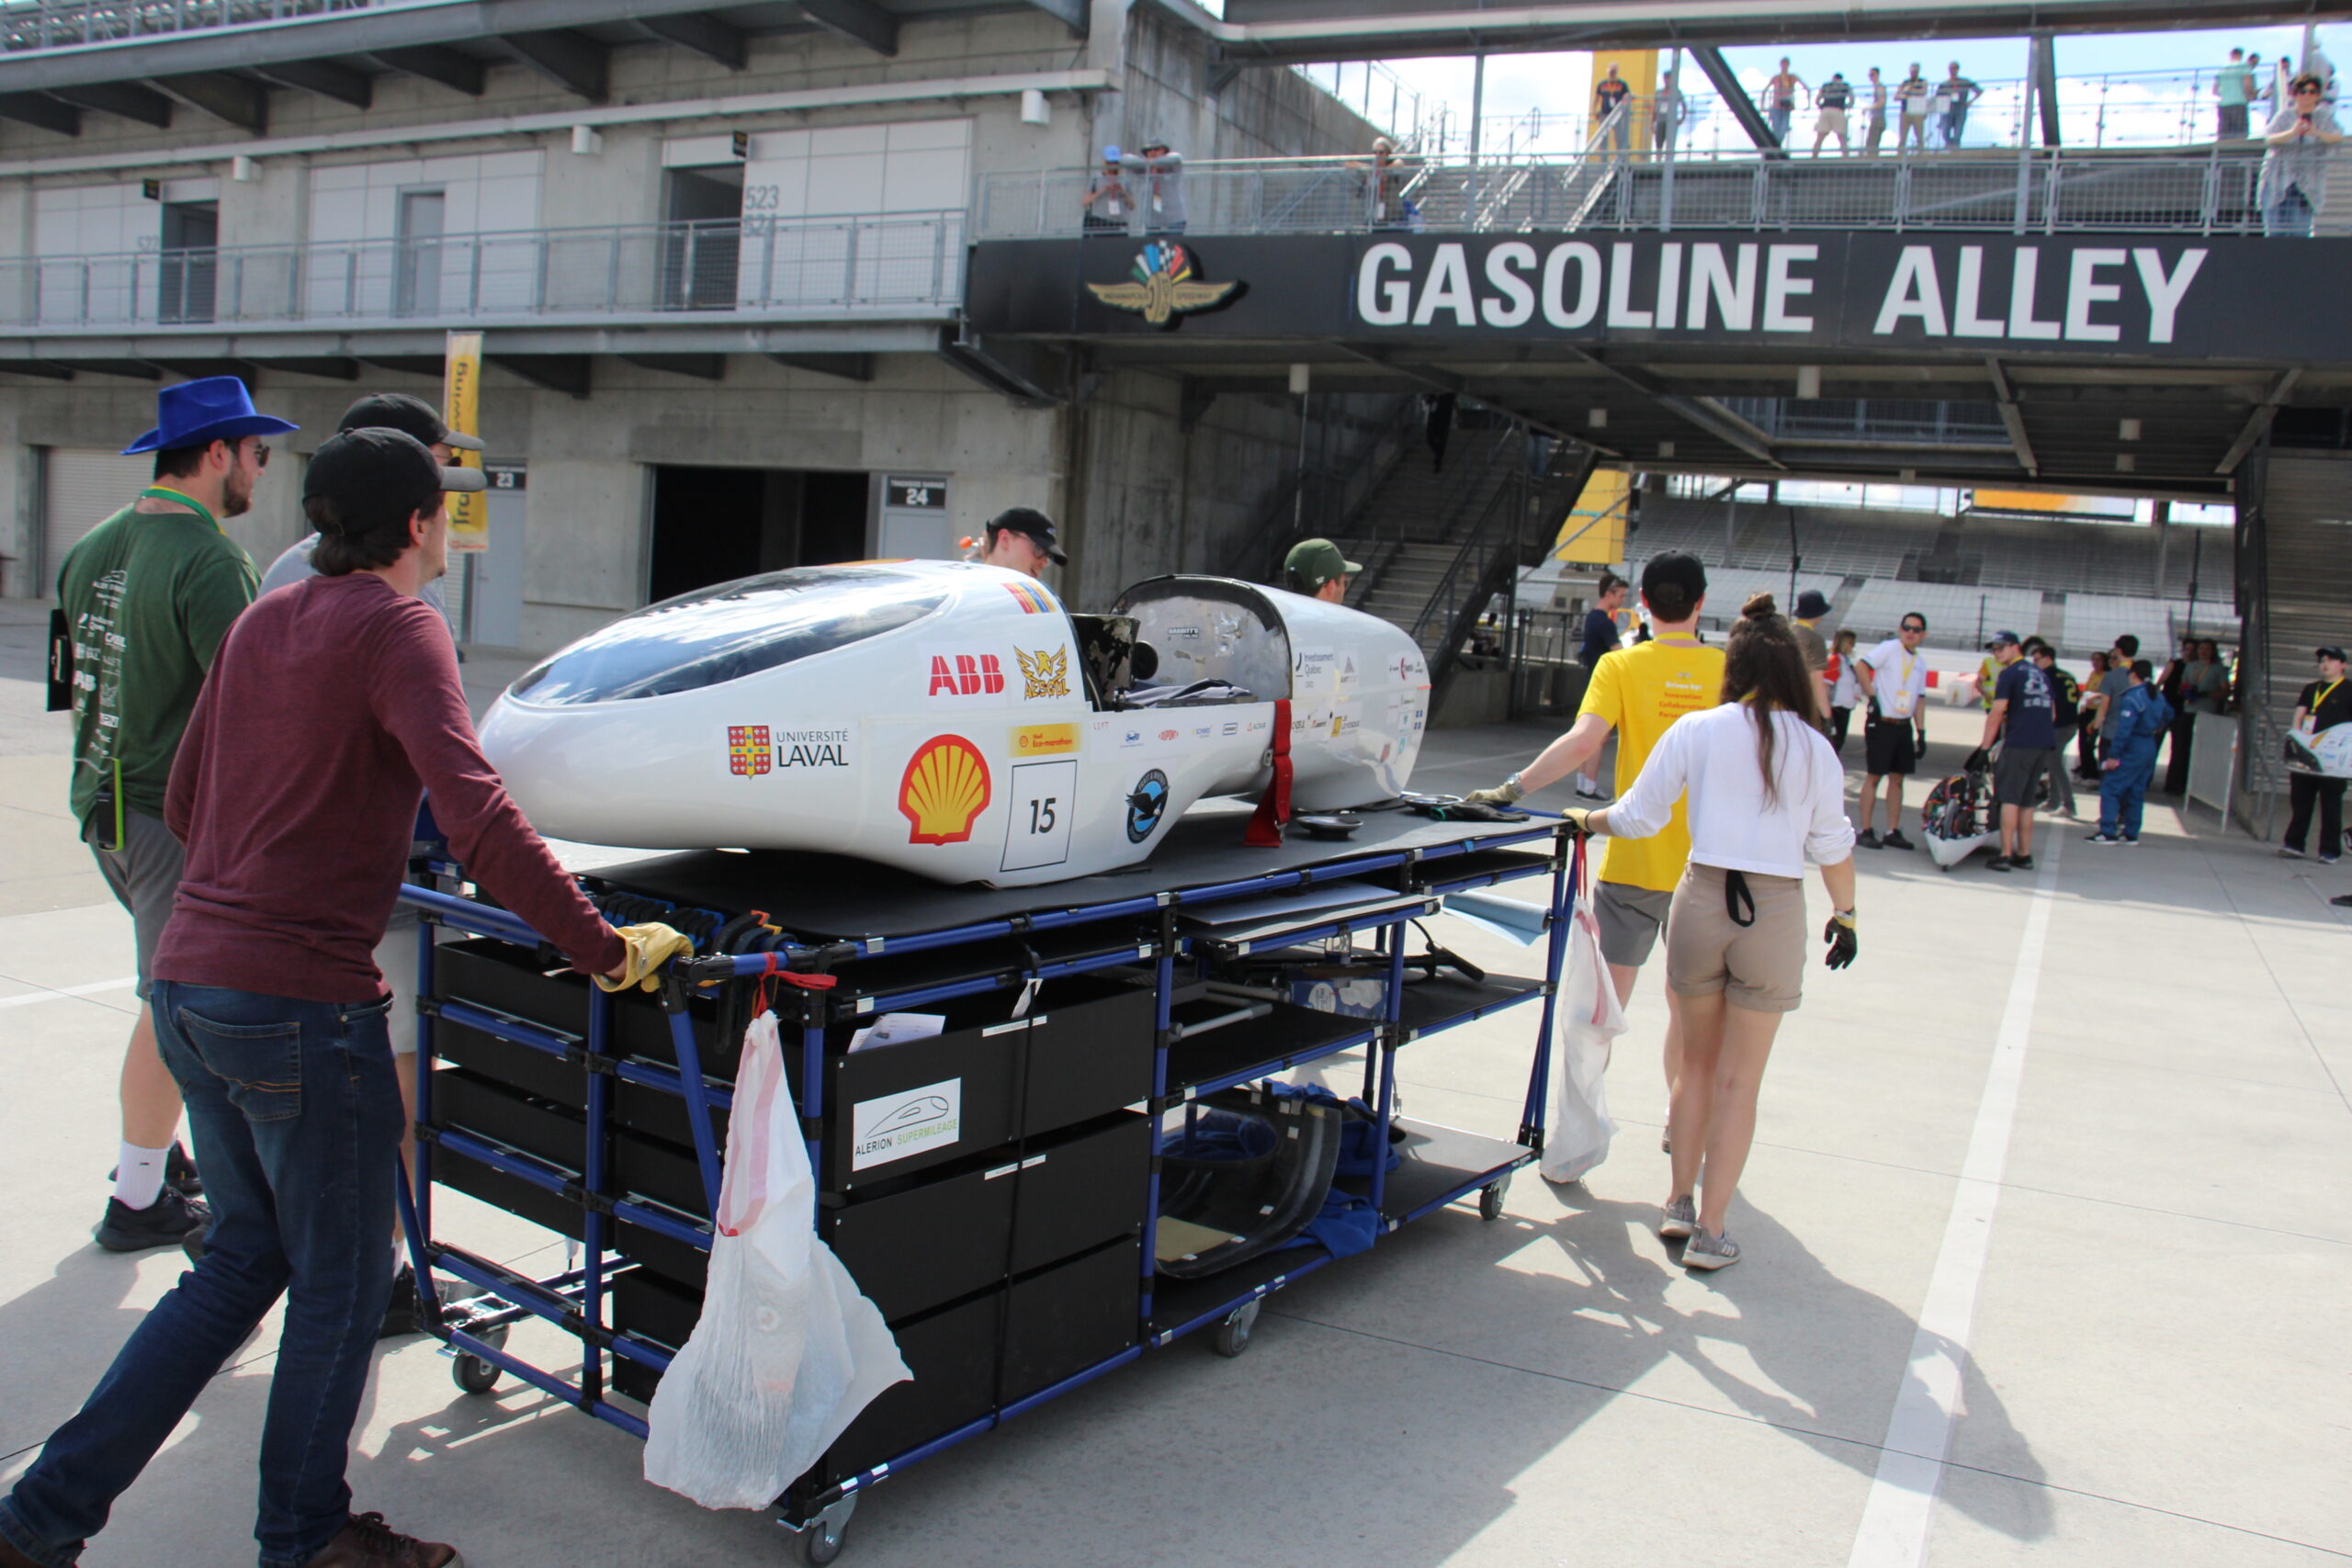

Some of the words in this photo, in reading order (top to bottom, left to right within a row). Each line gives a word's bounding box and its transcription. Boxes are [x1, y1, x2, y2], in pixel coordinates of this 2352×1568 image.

[745, 185, 779, 209] 523
[1357, 241, 1818, 333] GASOLINE
[1872, 245, 2209, 344] ALLEY
[497, 472, 514, 488] 23
[906, 488, 929, 505] 24
[929, 654, 1004, 696] ABB
[1023, 678, 1070, 701] AESGUL
[776, 728, 849, 743] UNIVERSITÉ
[1032, 737, 1073, 749] Eco-marathon
[777, 744, 849, 768] LAVAL
[1030, 796, 1057, 835] 15
[854, 1136, 893, 1156] ALERION
[897, 1118, 958, 1145] SUPERMILEAGE
